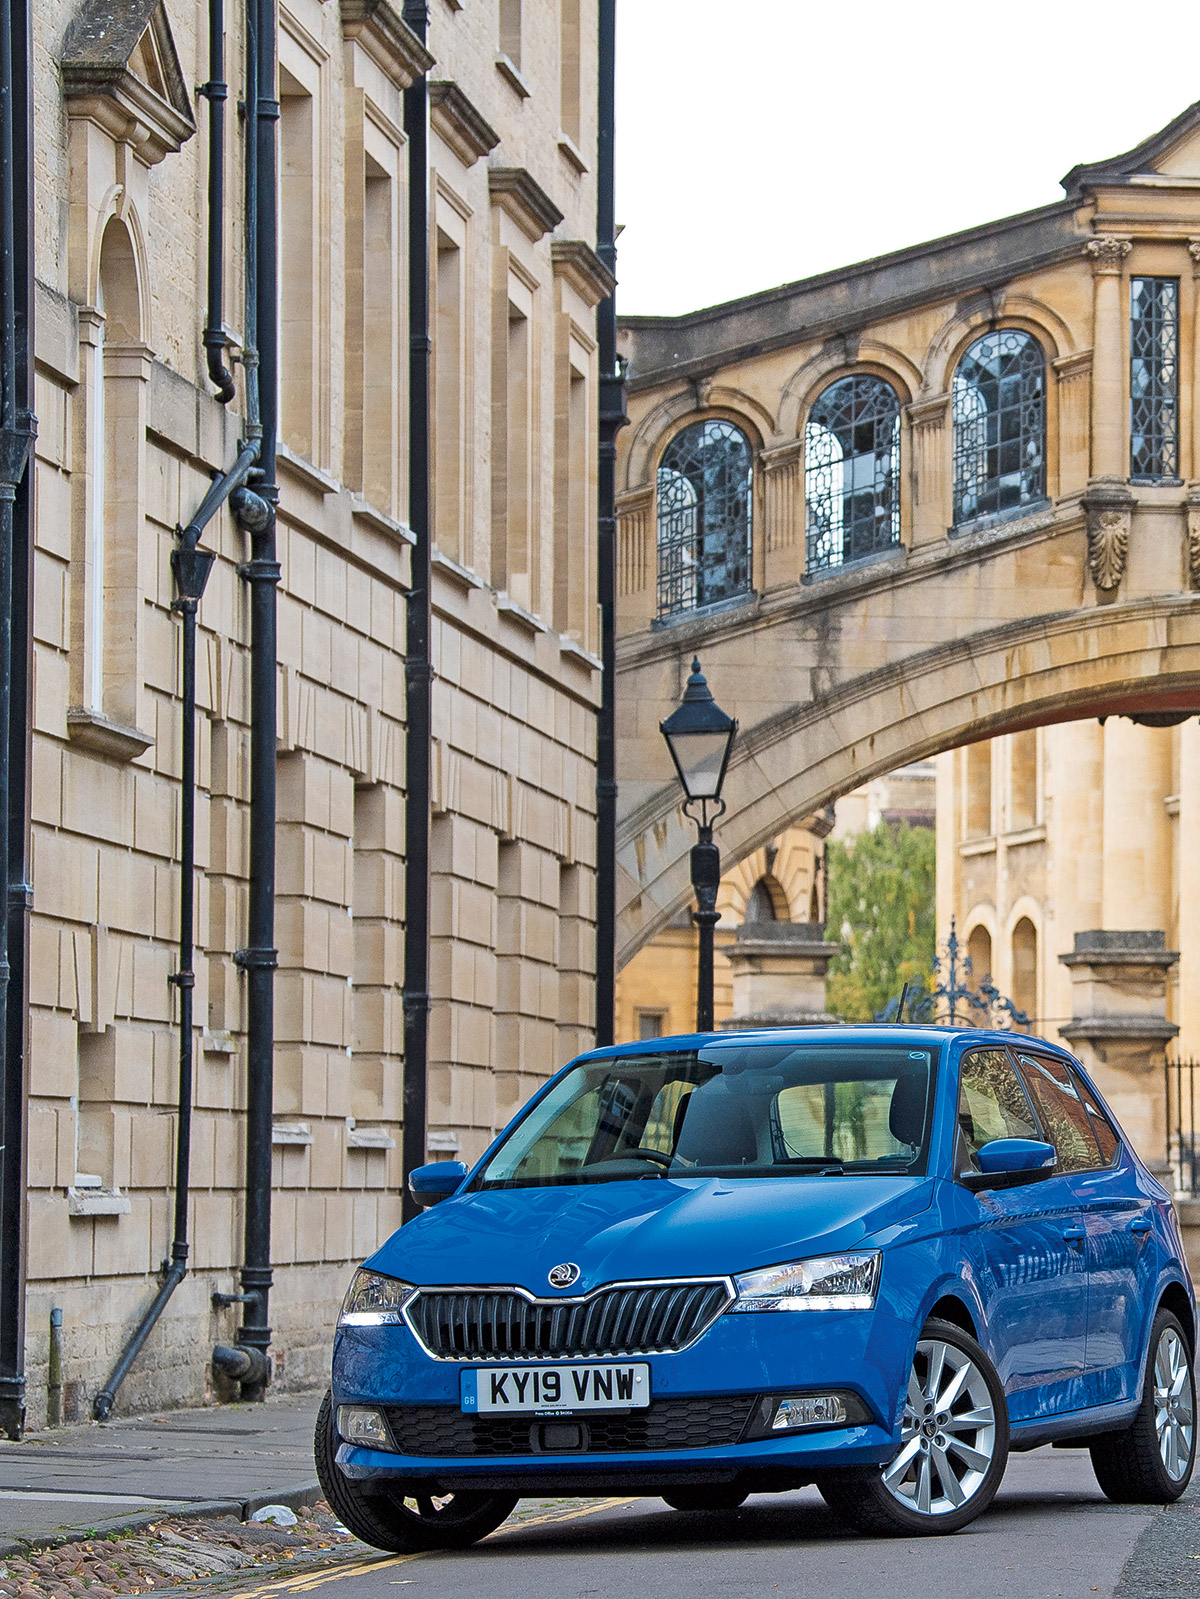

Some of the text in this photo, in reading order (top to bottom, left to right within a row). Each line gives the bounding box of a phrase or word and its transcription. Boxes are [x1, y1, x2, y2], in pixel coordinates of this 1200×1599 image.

[491, 1368, 634, 1404] KY19 VNW
[464, 1396, 475, 1405] GB
